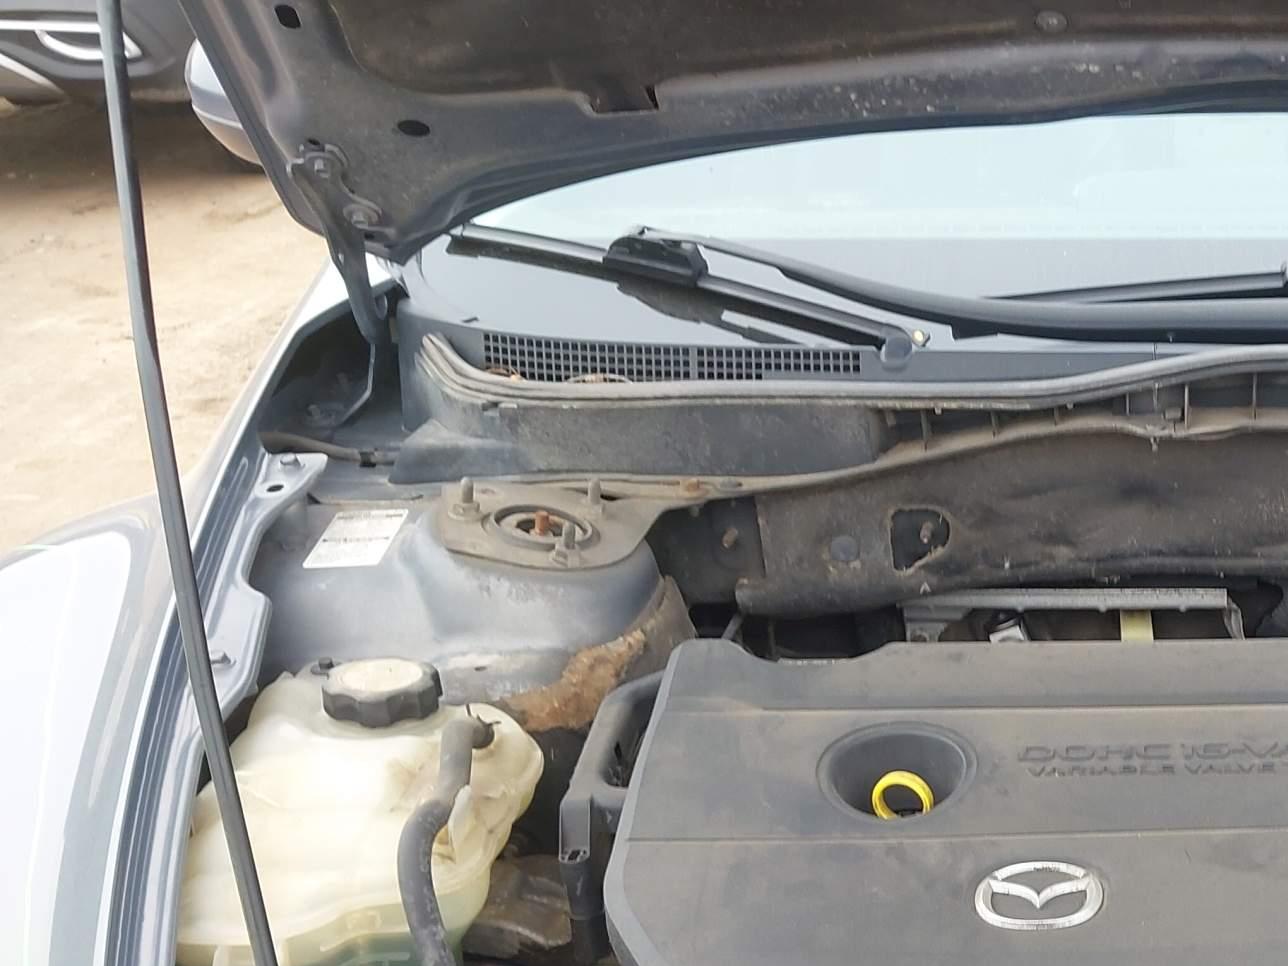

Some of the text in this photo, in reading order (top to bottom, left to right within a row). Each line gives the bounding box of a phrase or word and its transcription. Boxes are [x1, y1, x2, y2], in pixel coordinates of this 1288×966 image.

[1017, 743, 1173, 762] DOHC
[1026, 764, 1176, 777] VARIABLE
[1184, 762, 1275, 775] VALVE
